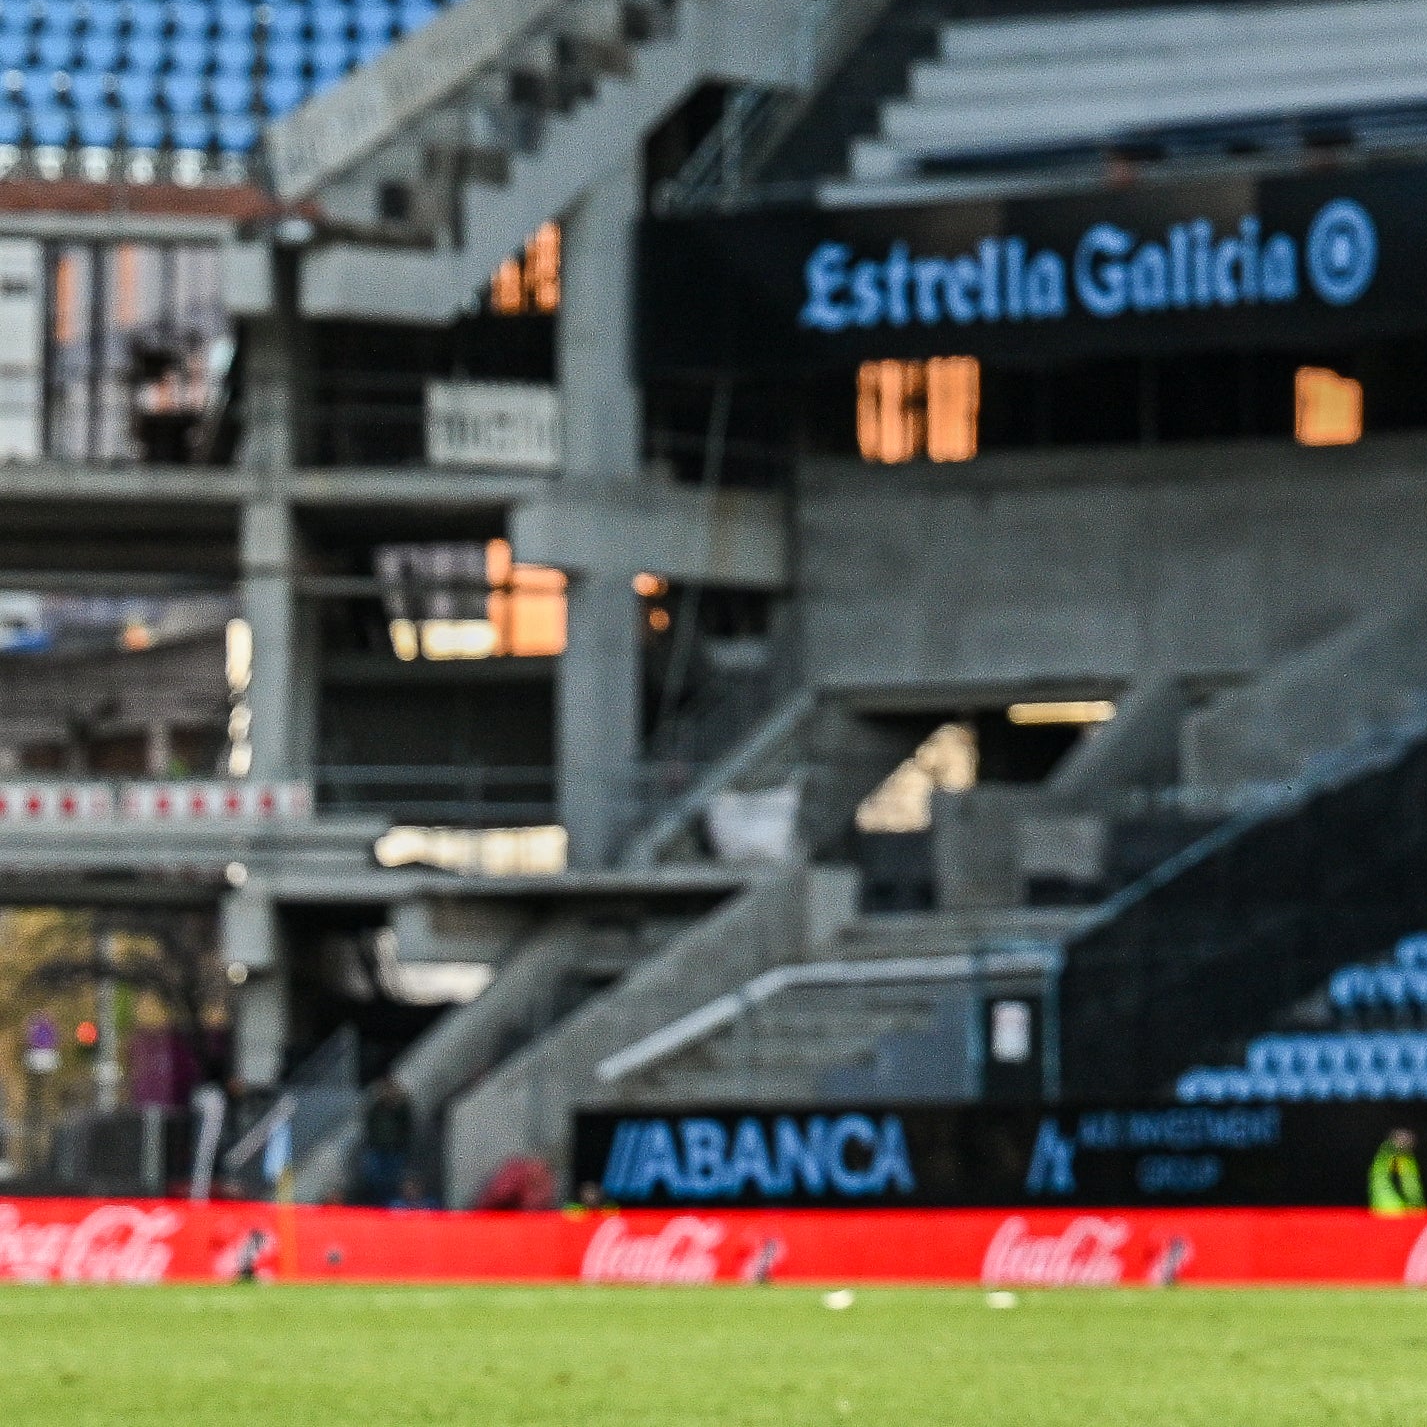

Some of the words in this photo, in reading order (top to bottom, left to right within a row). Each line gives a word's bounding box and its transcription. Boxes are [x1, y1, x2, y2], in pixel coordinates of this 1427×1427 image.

[798, 237, 1068, 332] Estrella
[1074, 214, 1298, 317] Galicia
[625, 1114, 916, 1199] ABANCA
